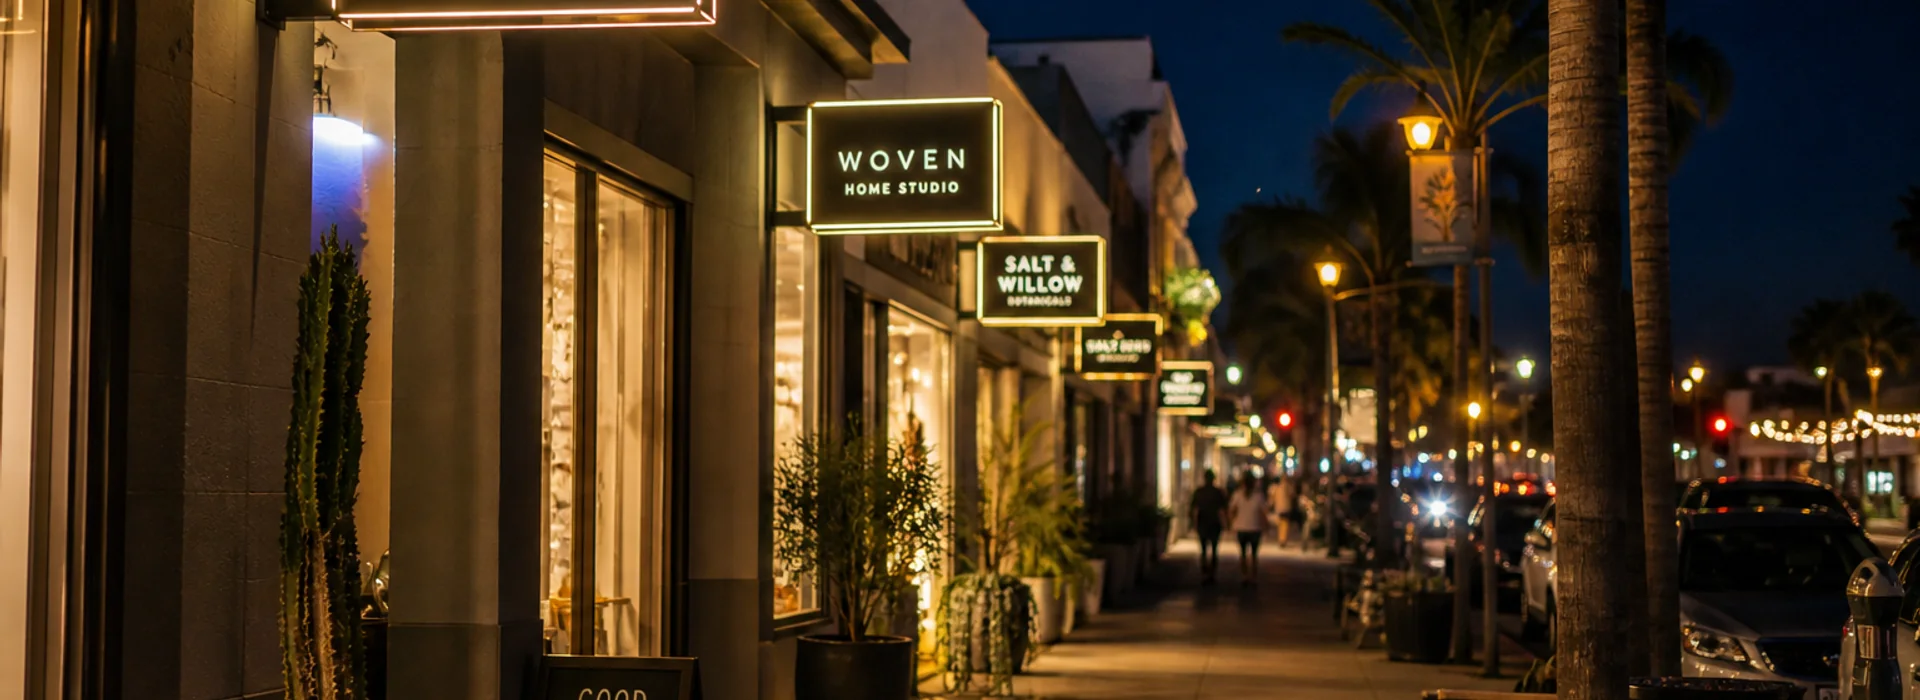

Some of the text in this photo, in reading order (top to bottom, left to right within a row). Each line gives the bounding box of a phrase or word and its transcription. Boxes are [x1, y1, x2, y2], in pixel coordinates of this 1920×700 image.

[838, 148, 965, 172] WOVEN
[844, 181, 959, 196] HOME STUDIO
[1004, 254, 1076, 274] SALT &
[997, 275, 1083, 294] WILLOW
